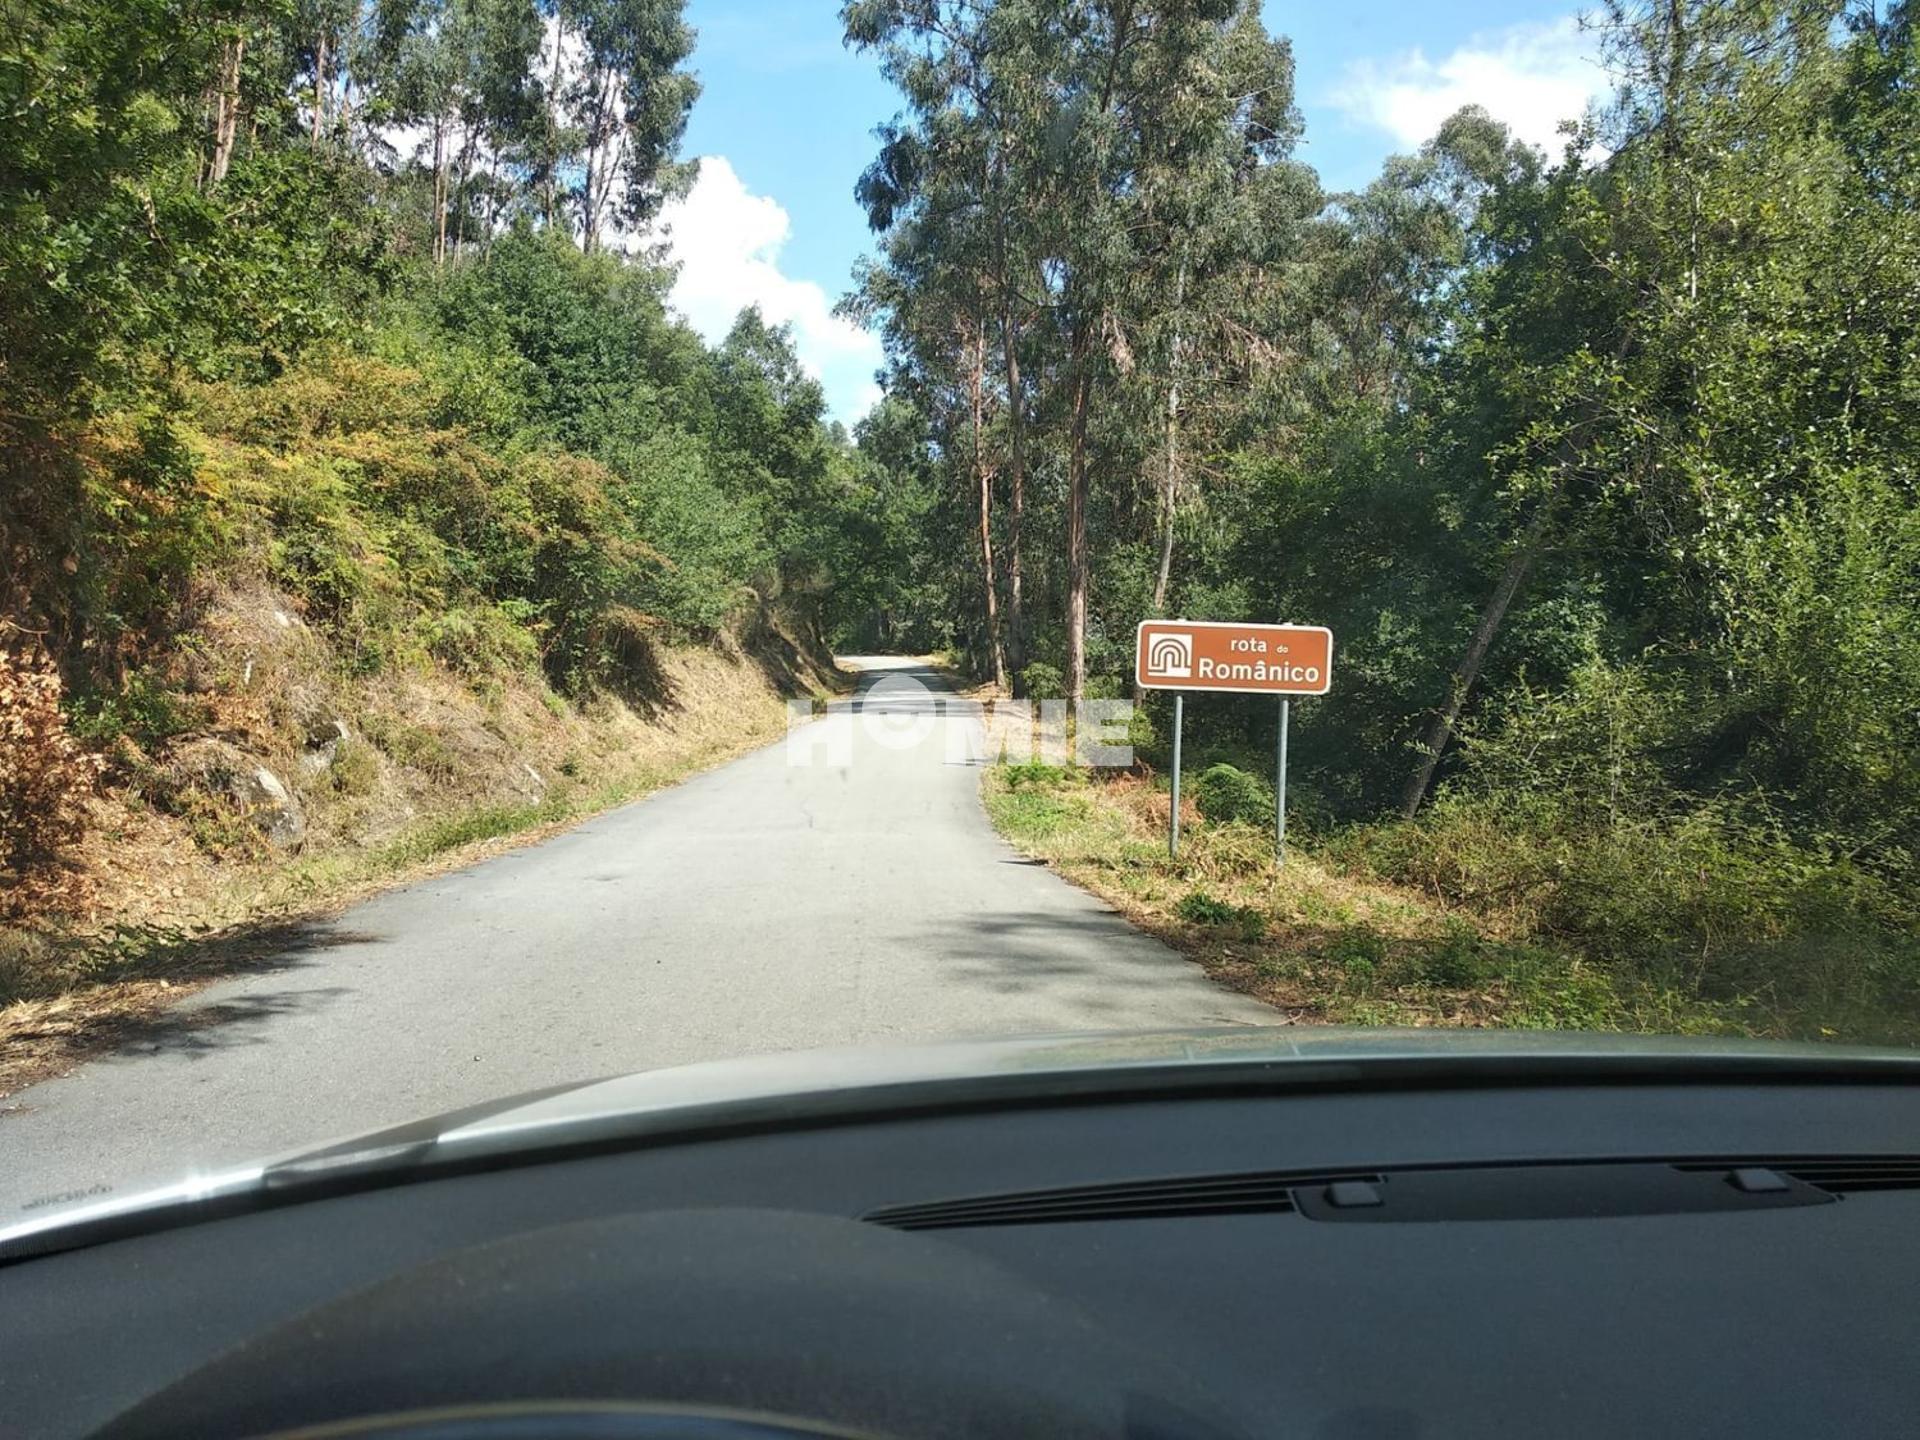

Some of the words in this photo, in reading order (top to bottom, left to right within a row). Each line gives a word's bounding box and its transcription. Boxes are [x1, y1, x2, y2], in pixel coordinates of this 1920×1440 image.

[1231, 637, 1267, 652] rota
[1276, 645, 1289, 653] do
[1199, 658, 1319, 682] Românico
